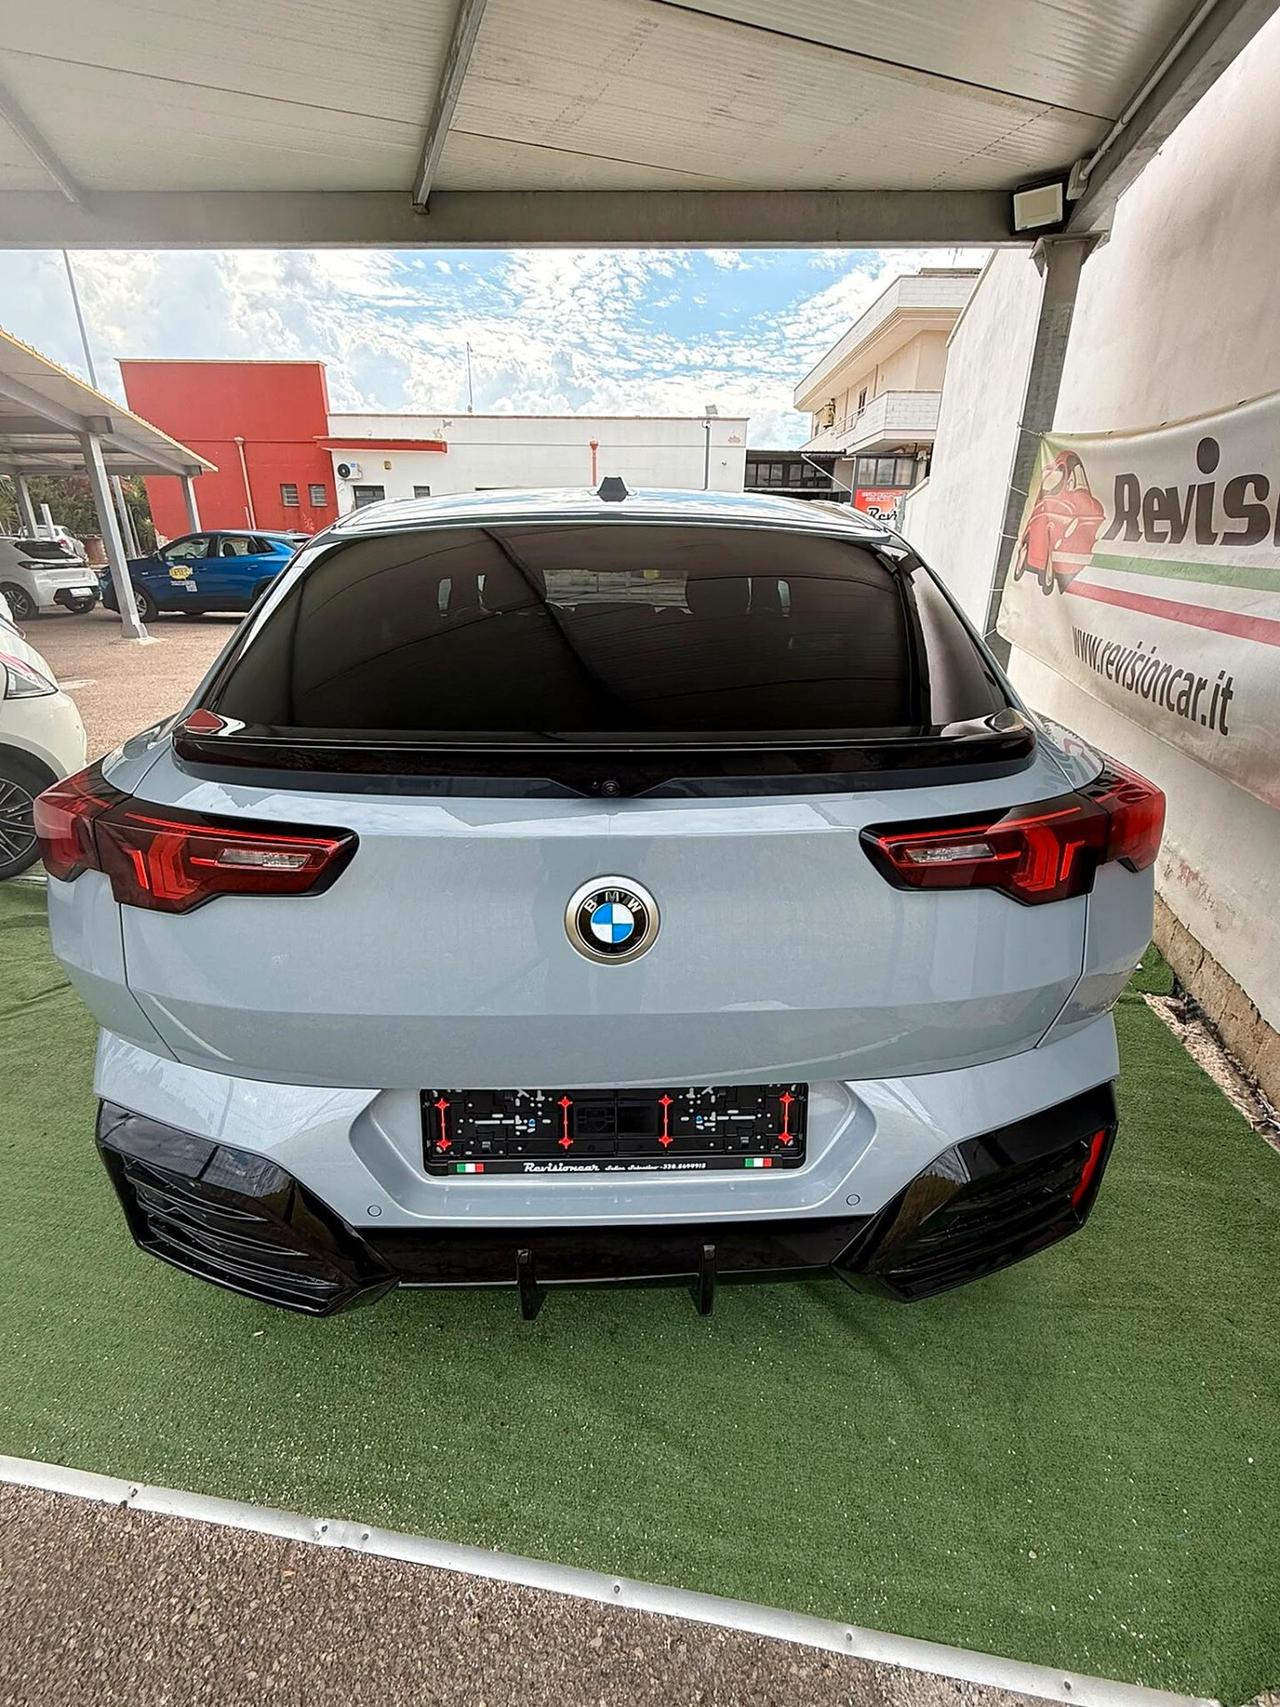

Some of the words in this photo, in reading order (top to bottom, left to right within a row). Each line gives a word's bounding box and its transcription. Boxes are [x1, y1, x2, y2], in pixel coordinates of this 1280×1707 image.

[1102, 437, 1280, 546] Revis
[1072, 626, 1234, 736] www.revisioncar.it
[583, 891, 642, 914] BMW
[523, 1162, 600, 1173] Revisioncar
